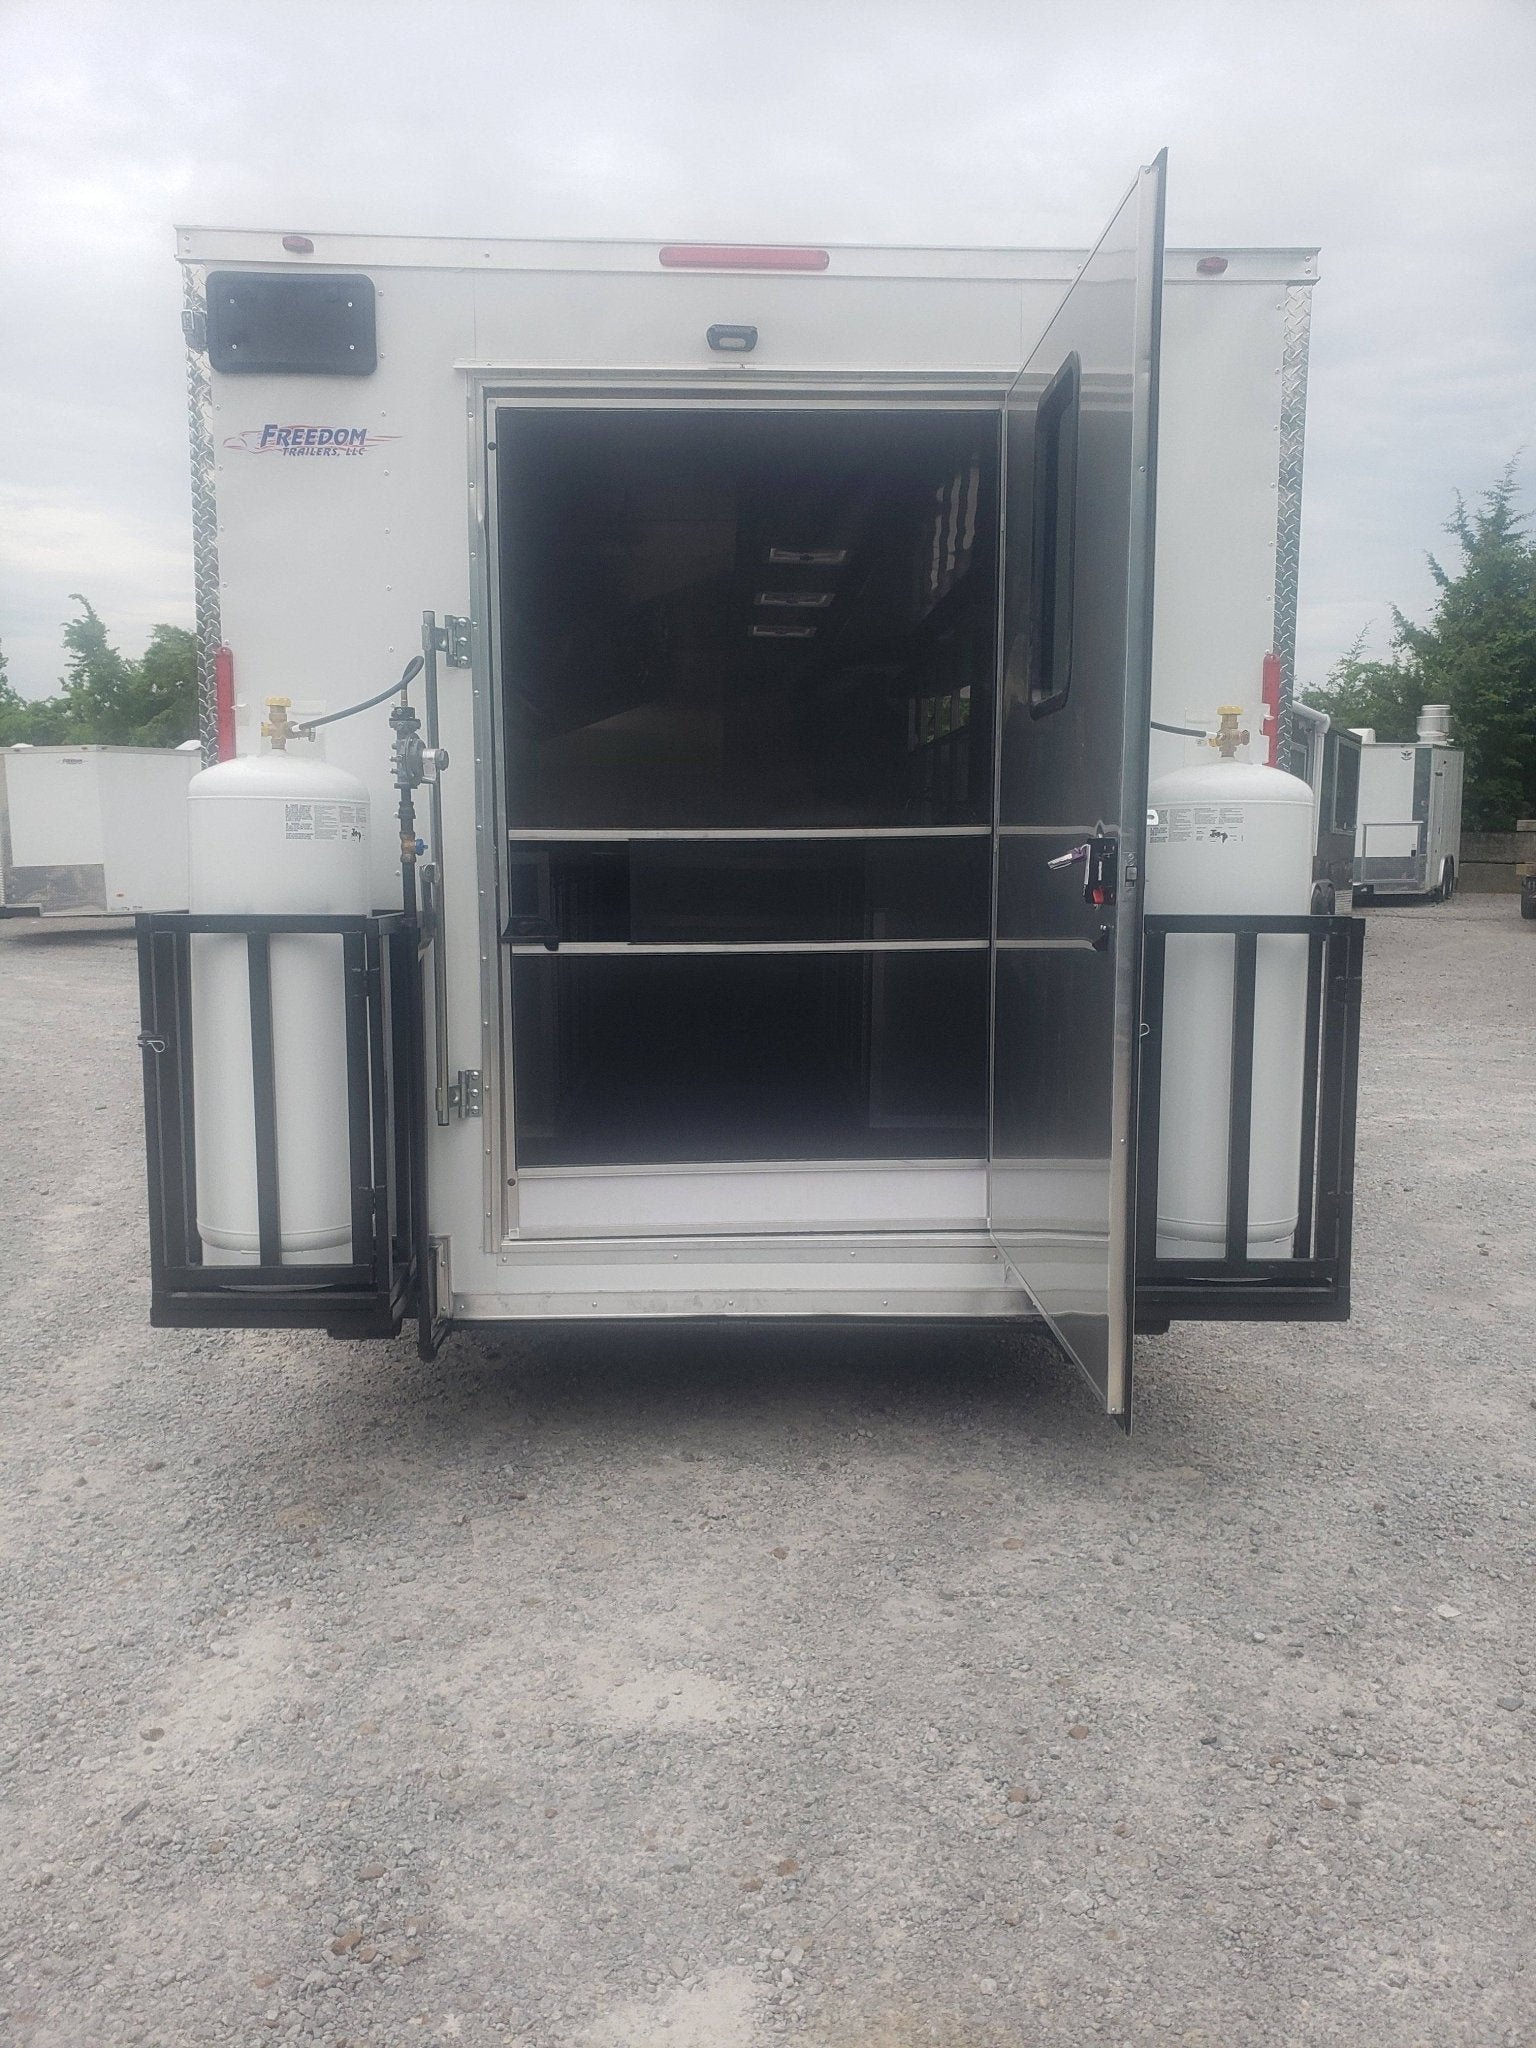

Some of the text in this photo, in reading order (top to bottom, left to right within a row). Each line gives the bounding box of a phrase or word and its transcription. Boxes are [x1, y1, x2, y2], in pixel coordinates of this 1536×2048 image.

[260, 424, 367, 447] FREEDOM
[282, 447, 365, 457] TRAILERS, LLC
